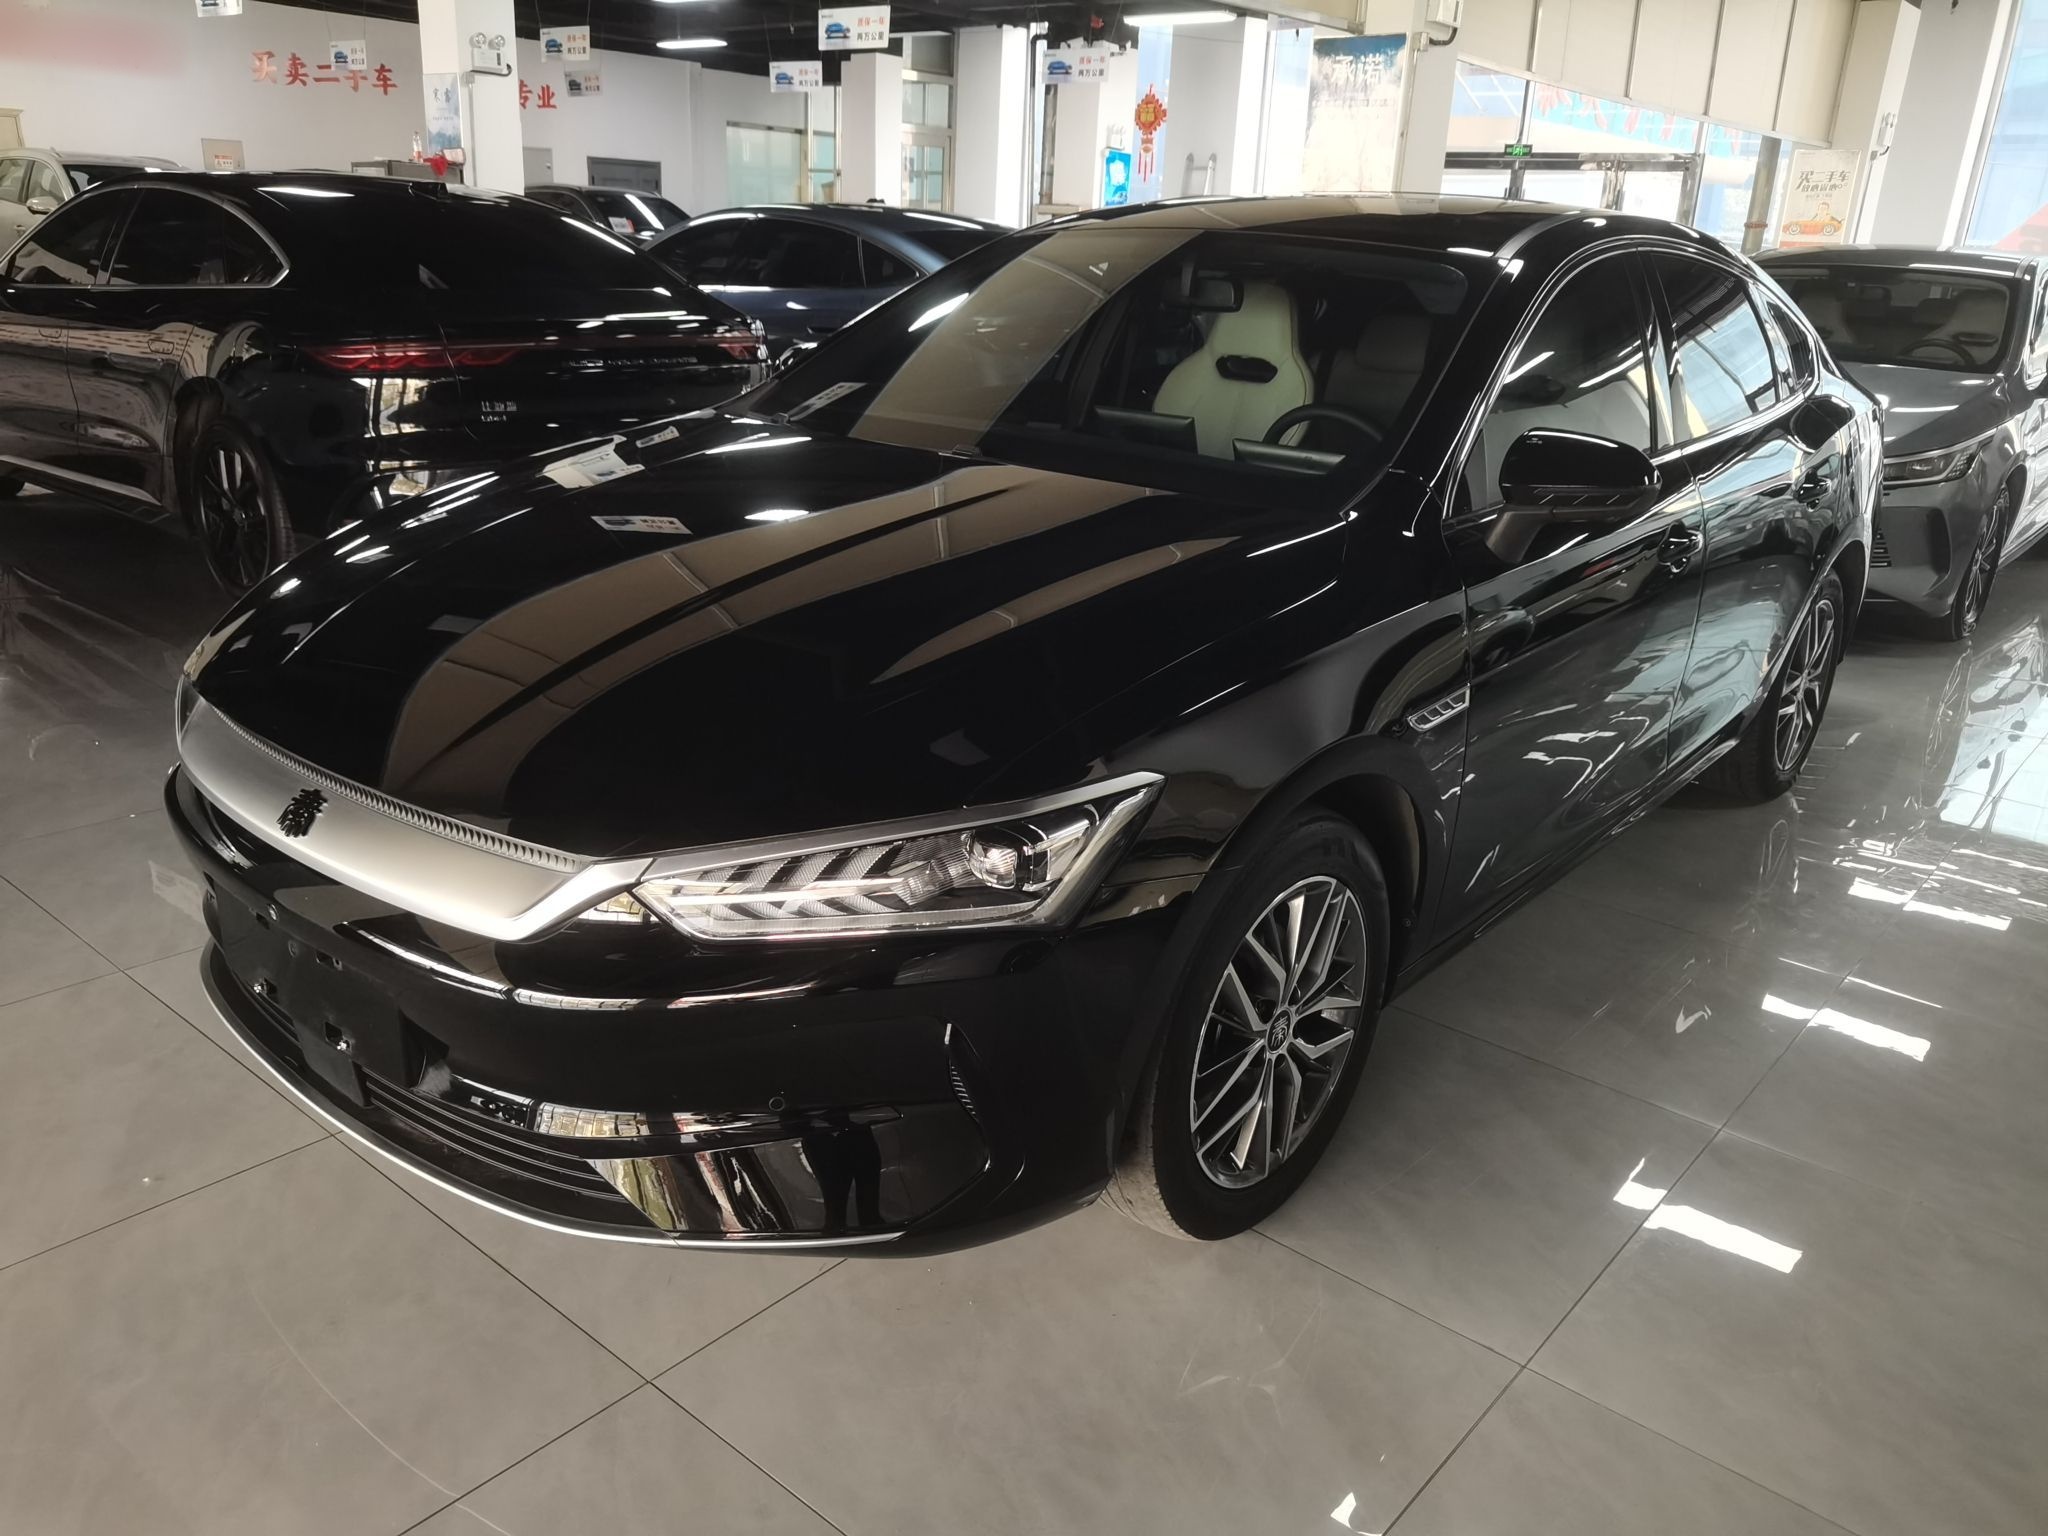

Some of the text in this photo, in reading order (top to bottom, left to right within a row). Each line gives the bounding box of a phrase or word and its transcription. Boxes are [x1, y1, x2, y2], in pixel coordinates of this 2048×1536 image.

[252, 51, 398, 96] 买卖二手车
[1796, 170, 1851, 190] 买二手车
